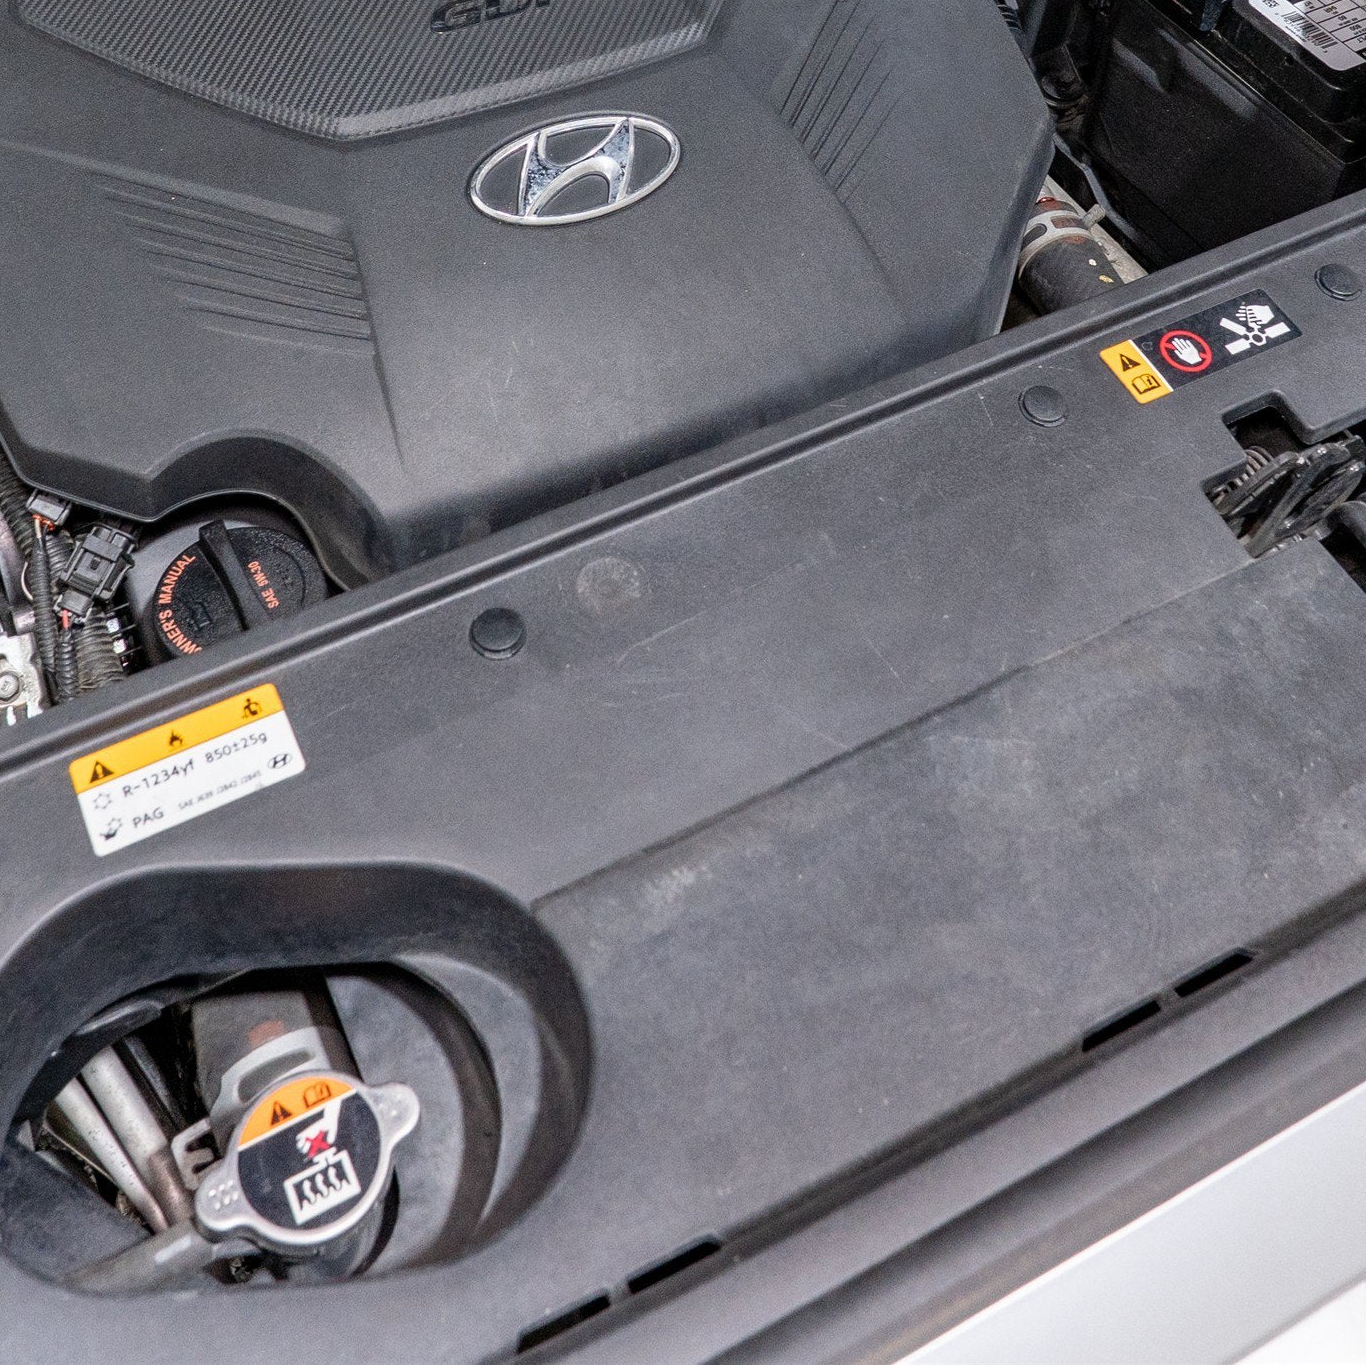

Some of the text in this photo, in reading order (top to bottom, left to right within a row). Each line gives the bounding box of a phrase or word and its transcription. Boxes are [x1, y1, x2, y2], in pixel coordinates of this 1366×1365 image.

[158, 554, 196, 605] MANUAL
[261, 587, 280, 610] SAE
[121, 731, 268, 799] R-1234yf 850±25g
[132, 807, 165, 828] PAG
